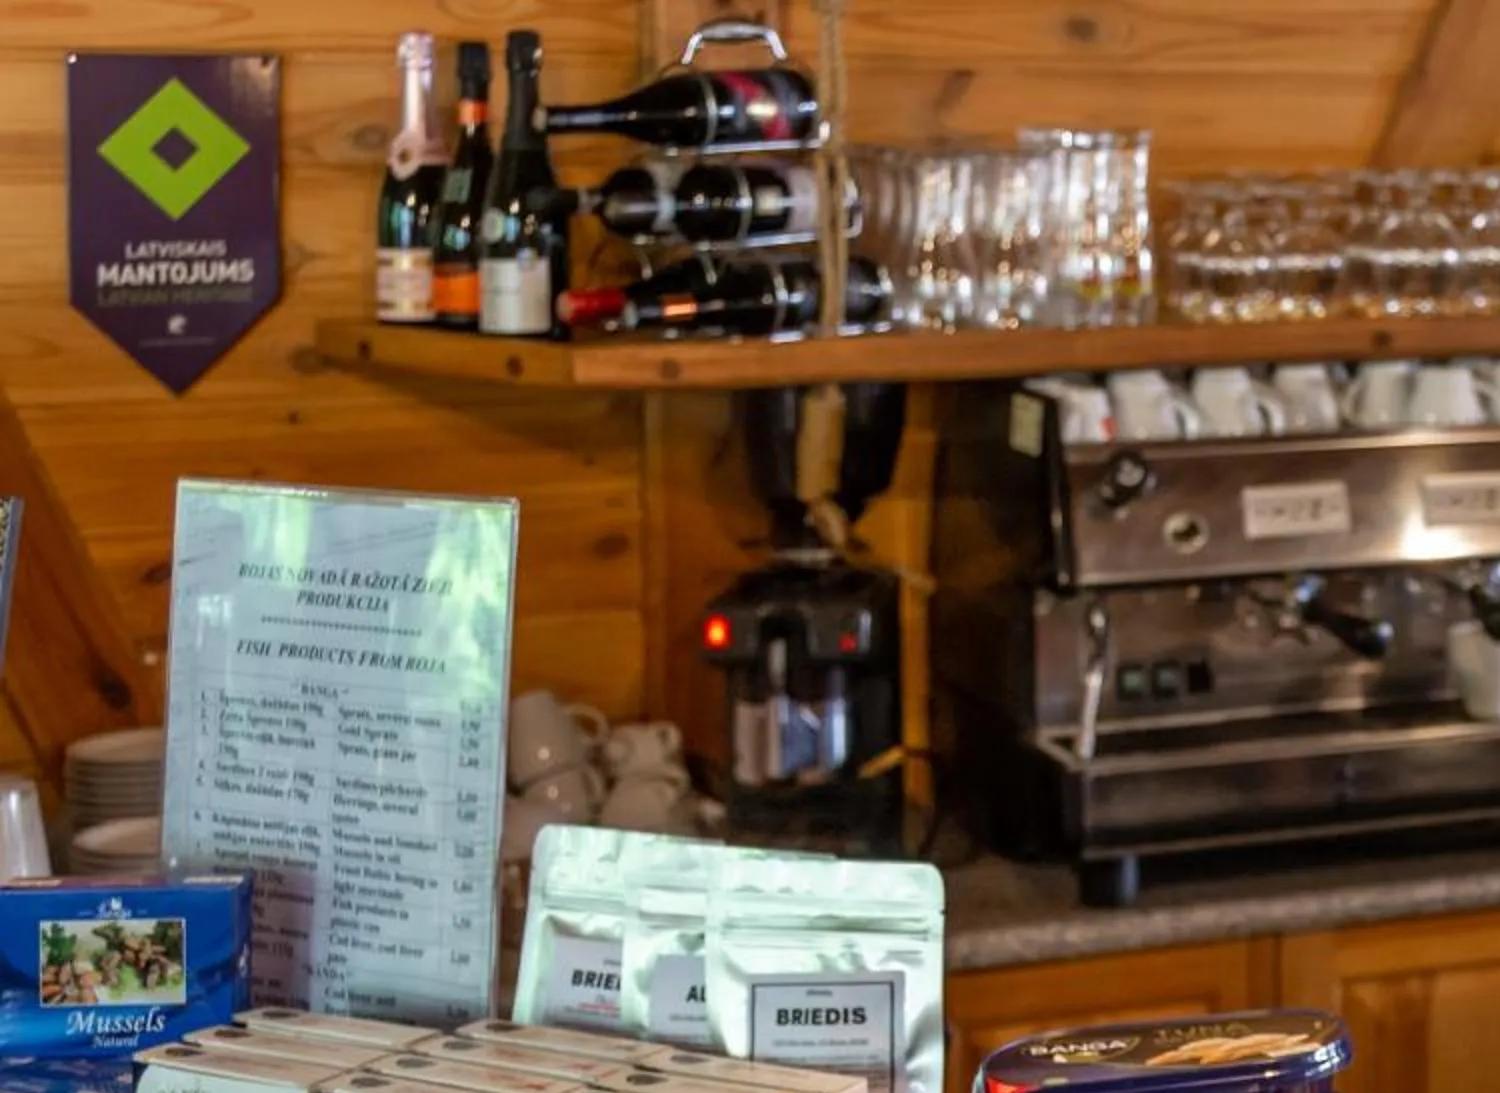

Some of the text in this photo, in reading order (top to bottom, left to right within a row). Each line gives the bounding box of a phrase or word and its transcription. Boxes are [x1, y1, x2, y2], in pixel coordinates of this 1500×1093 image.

[125, 239, 227, 260] LATVISKAIS
[97, 257, 255, 287] MANTOJUMS
[296, 590, 391, 614] PRODUKCIJA
[237, 638, 446, 674] FISH PRODUCTS FROM ROJA
[571, 968, 621, 992] BRIE
[66, 1005, 166, 1036] Mussels
[775, 1006, 867, 1027] BRIEDIS
[93, 1033, 139, 1050] Natural
[1027, 1036, 1130, 1057] BANGA
